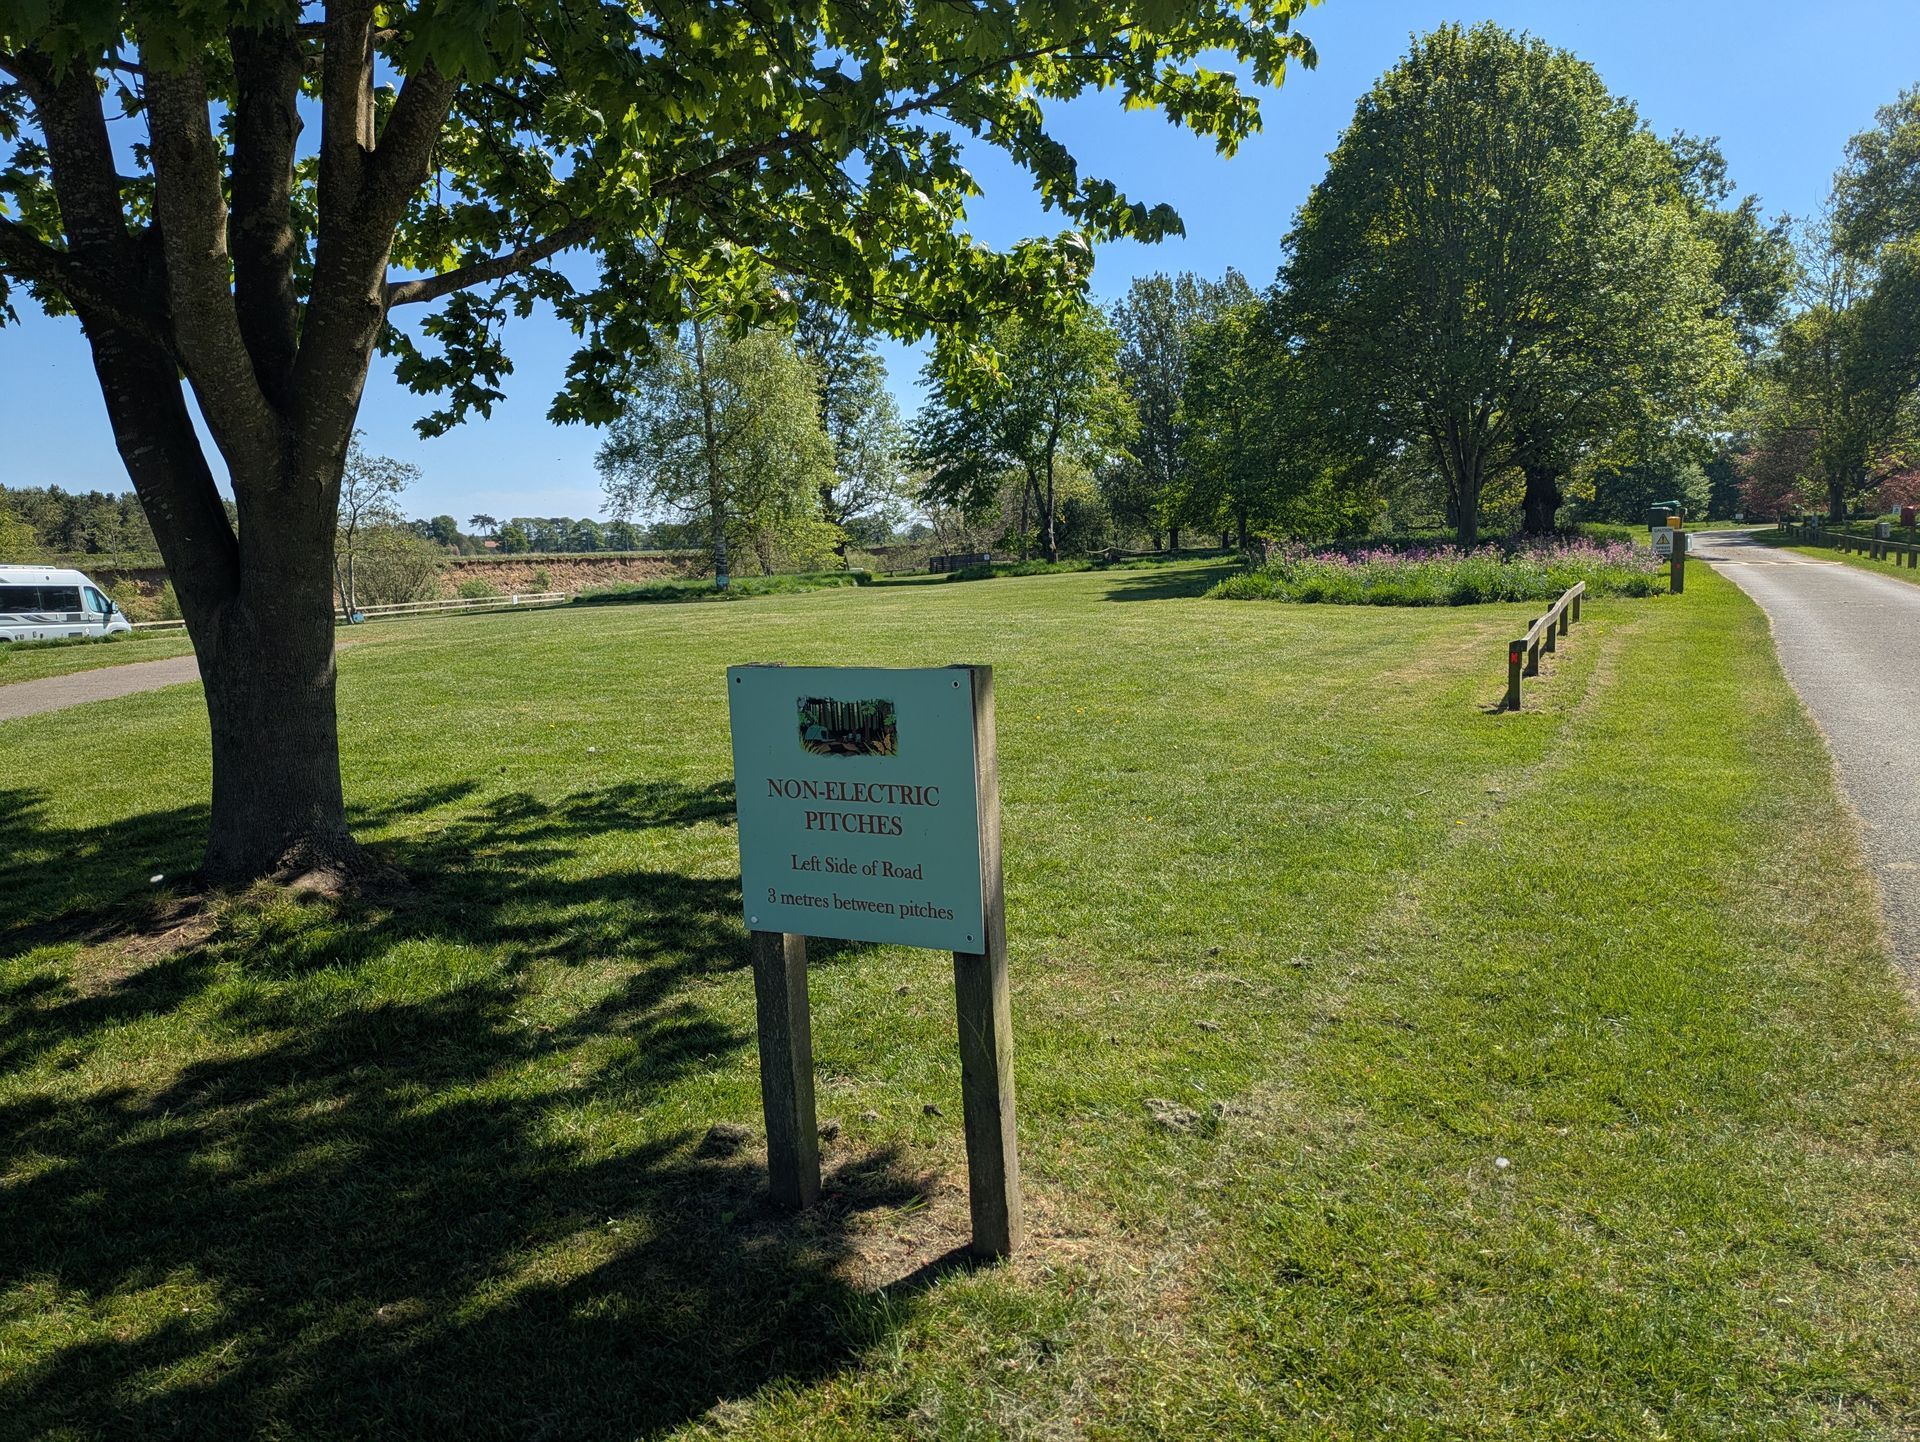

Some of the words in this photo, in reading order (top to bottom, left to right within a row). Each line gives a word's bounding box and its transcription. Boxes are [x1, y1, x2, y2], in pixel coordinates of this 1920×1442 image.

[767, 778, 940, 807] NON-ELECTRIC
[804, 811, 903, 836] PITCHES
[791, 854, 821, 872] Left
[825, 857, 857, 875] Side
[862, 860, 878, 876] of
[882, 861, 923, 880] Road
[768, 888, 776, 903] 3
[781, 893, 829, 908] metres
[833, 893, 895, 915] between
[900, 900, 954, 920] pitches
